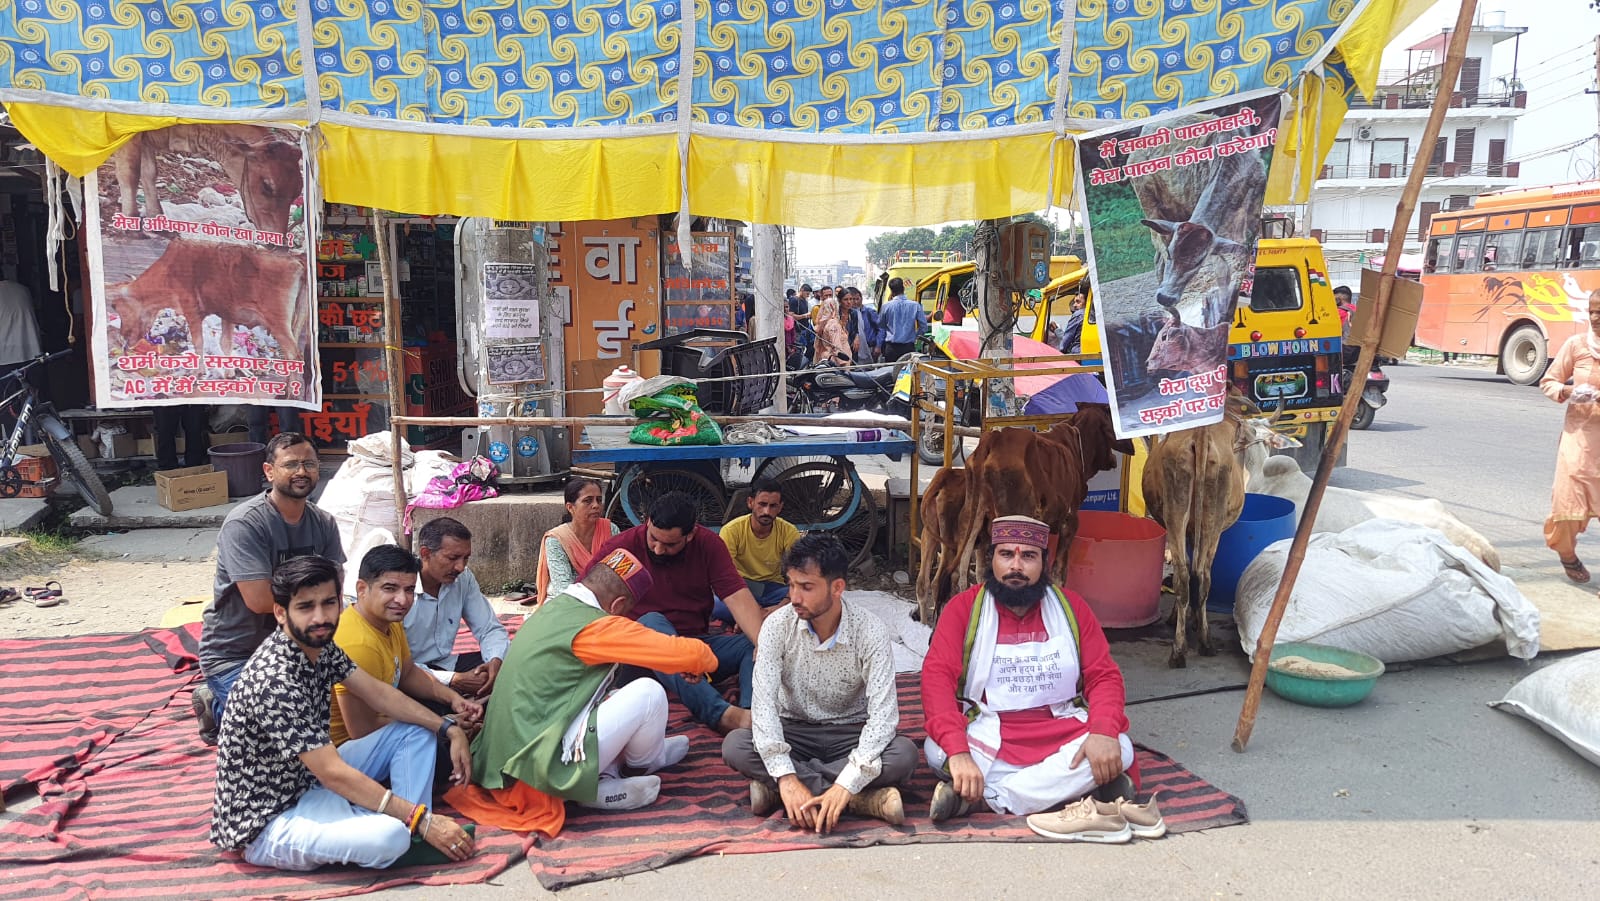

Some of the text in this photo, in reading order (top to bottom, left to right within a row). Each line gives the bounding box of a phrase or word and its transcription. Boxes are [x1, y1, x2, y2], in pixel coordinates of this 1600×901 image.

[1099, 107, 1262, 159] मैं सबकी पालनहारी,
[1090, 167, 1121, 186] मेरा
[1123, 158, 1172, 178] पालन
[1175, 144, 1214, 167] कौन
[112, 213, 140, 231] मेरा
[143, 214, 199, 235] अधिकार
[201, 220, 232, 238] कौन
[233, 227, 253, 242] खा
[256, 230, 284, 247] गया
[319, 302, 344, 327] की
[1241, 339, 1319, 358] BLOW HORN
[117, 352, 305, 376] शर्म करो सरकार तुम
[332, 360, 388, 383] 51%
[124, 376, 301, 397] AC में मैं सड़कों पर ?
[1159, 379, 1186, 395] मेरा
[1188, 373, 1212, 392] दूध
[1140, 399, 1184, 425] सड़कों
[1186, 399, 1207, 413] पर
